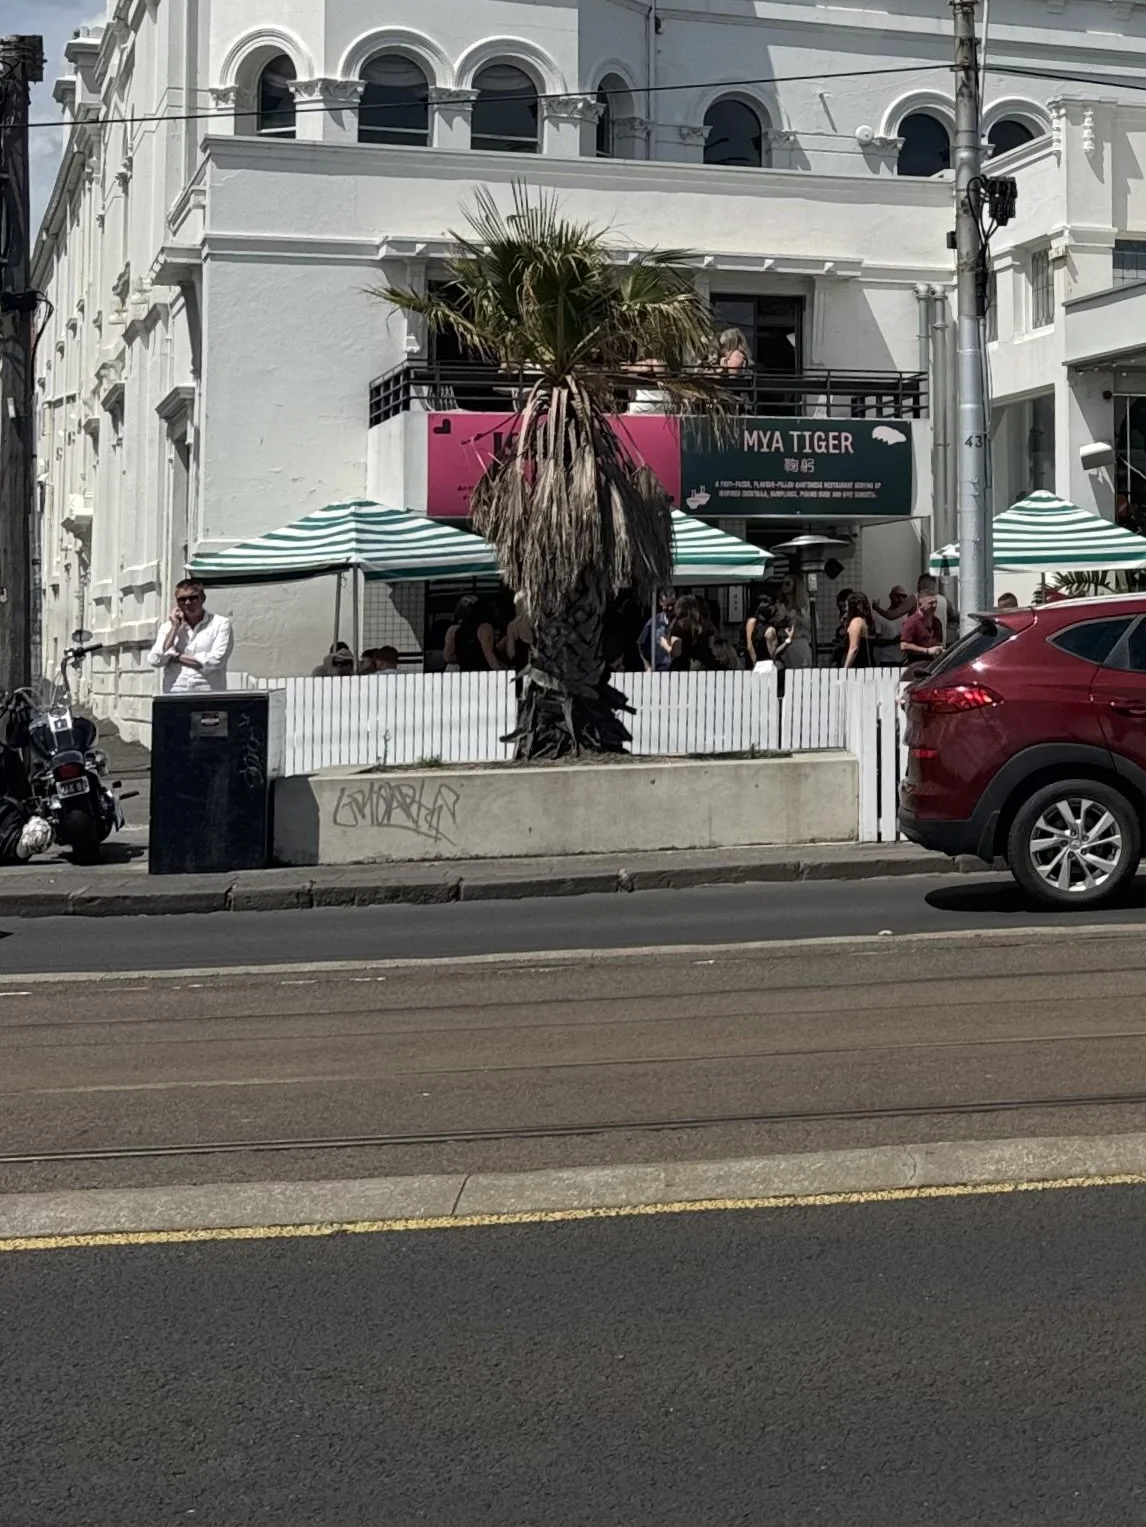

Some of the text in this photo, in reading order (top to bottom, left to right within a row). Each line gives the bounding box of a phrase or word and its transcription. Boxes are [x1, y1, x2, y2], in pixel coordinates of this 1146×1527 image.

[743, 430, 854, 454] MYA TIGER
[964, 434, 983, 448] 43
